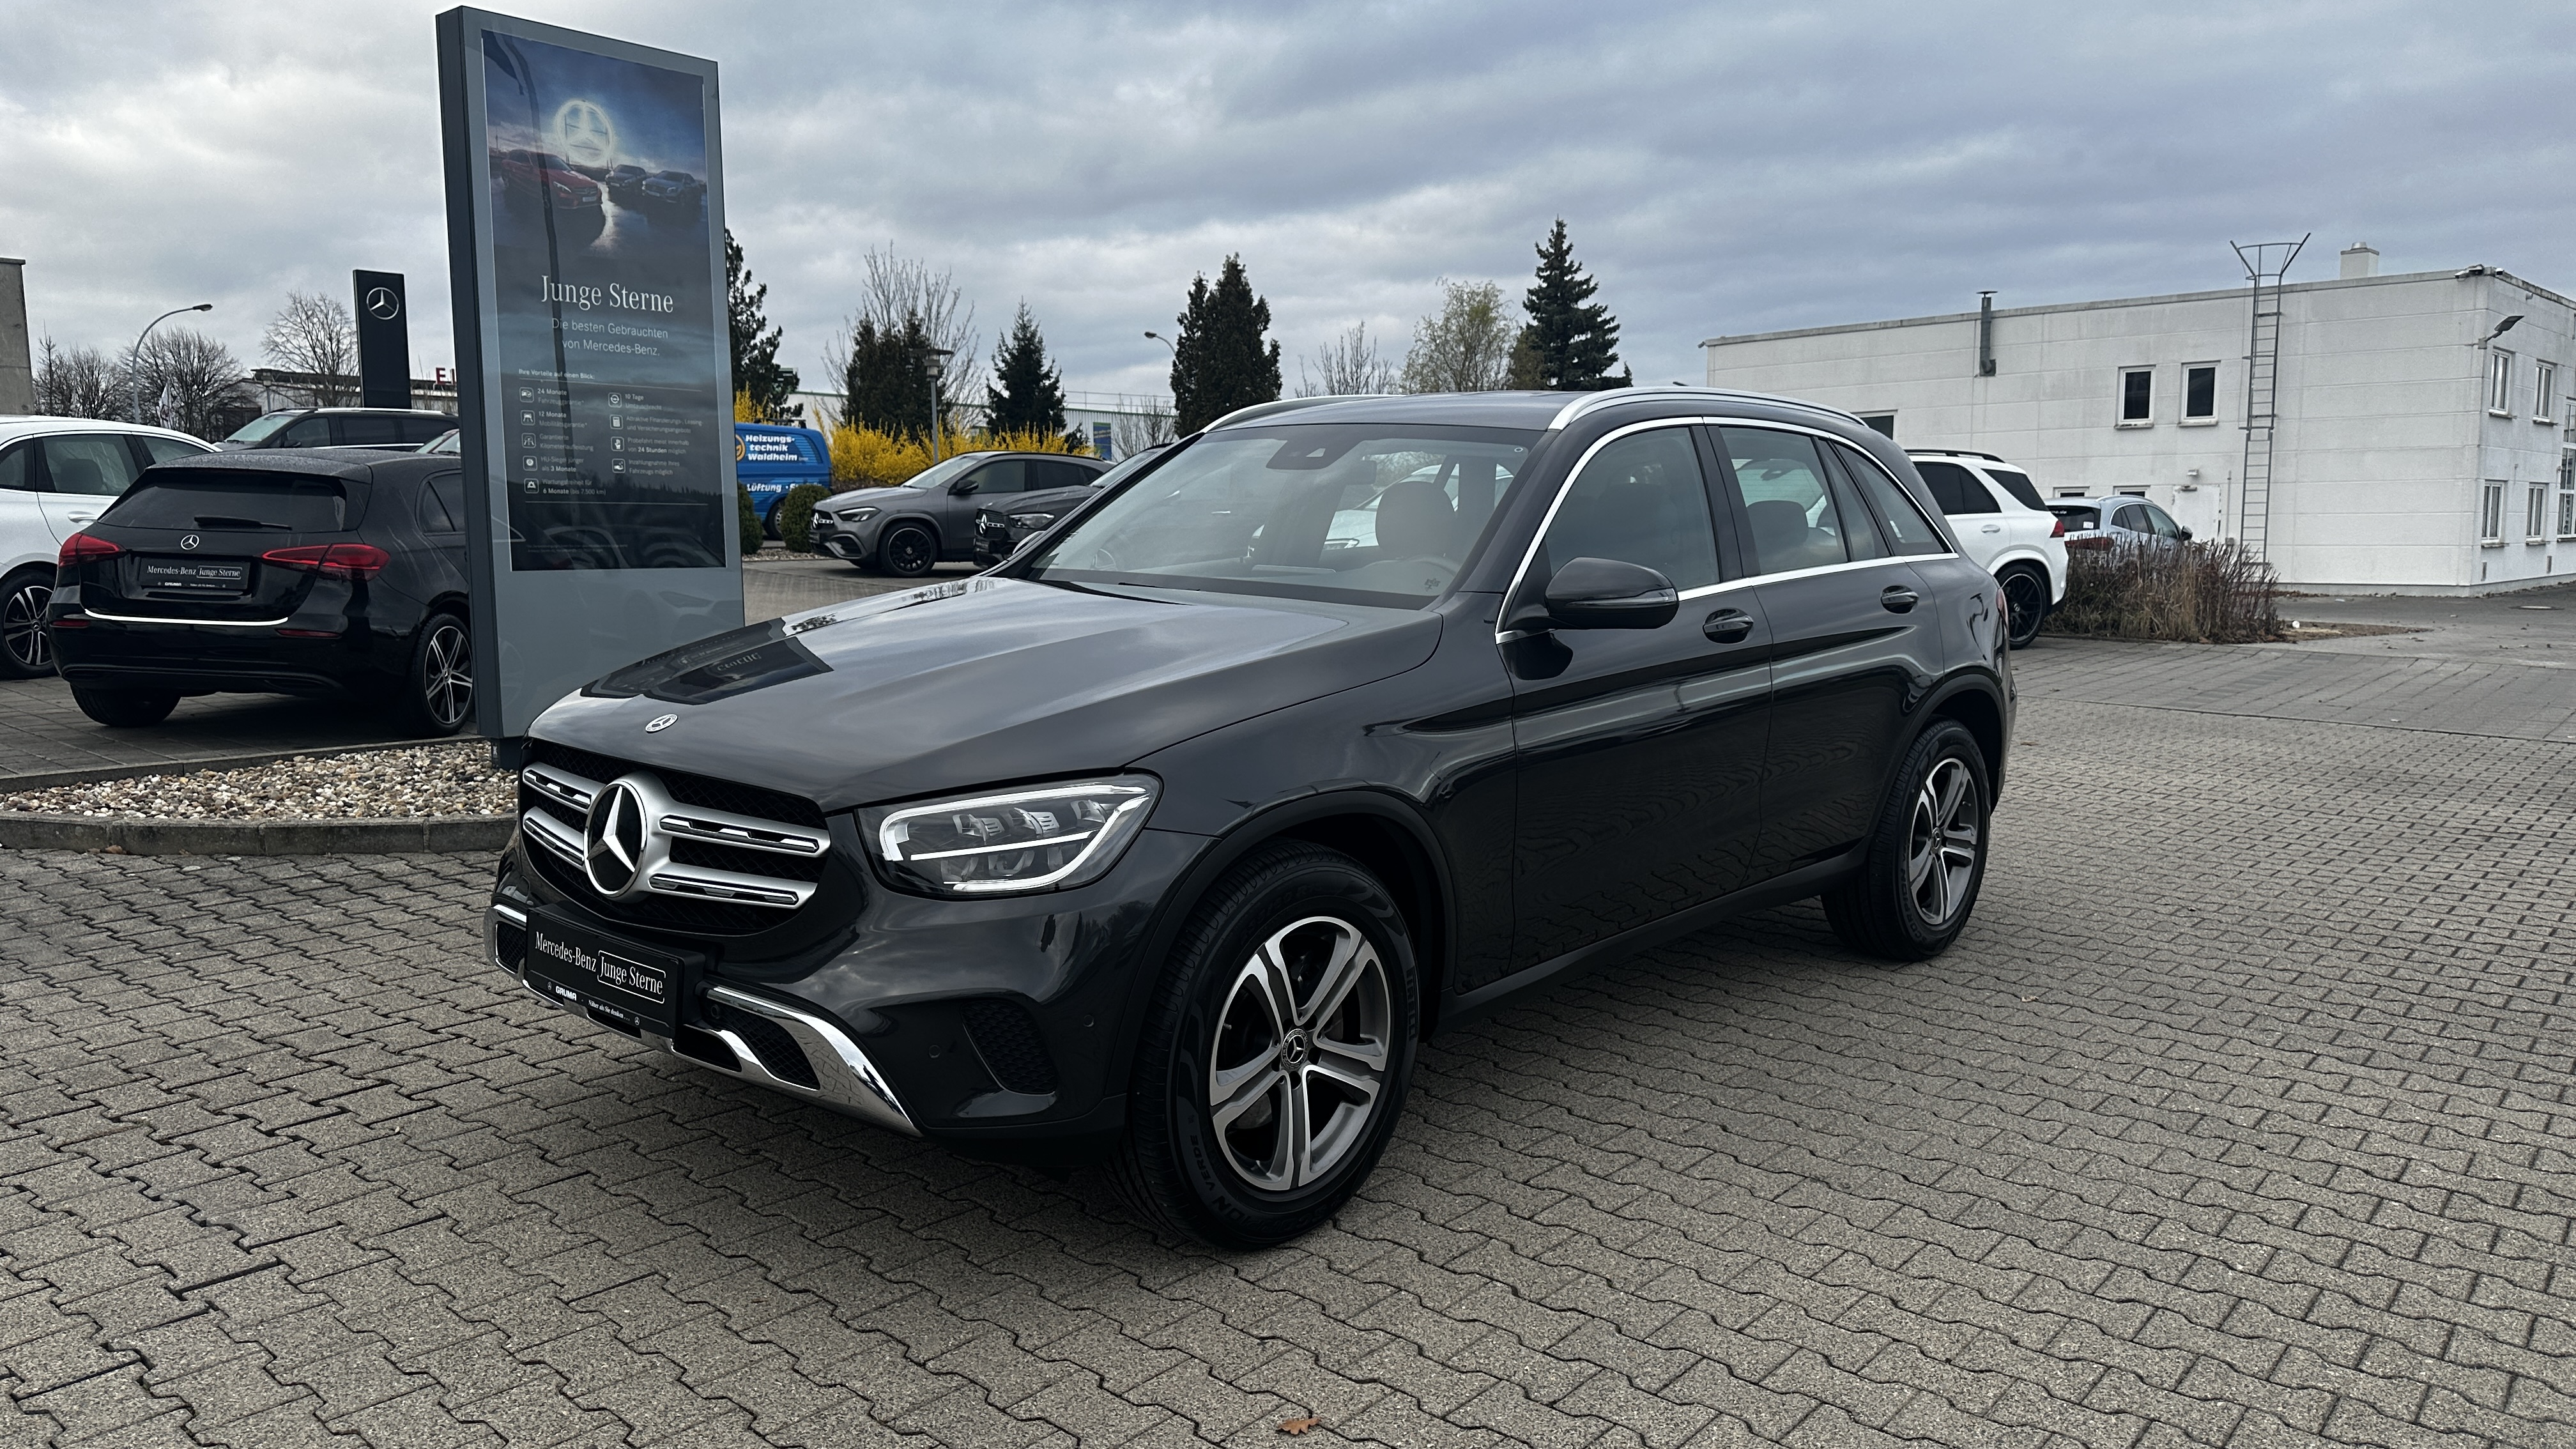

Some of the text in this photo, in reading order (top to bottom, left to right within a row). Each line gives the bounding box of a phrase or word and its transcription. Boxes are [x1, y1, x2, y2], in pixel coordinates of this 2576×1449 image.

[541, 275, 673, 313] Junge Sterne
[552, 318, 668, 339] Die besten Gebrauchten
[562, 339, 660, 356] von Mercedes-Benz.
[746, 434, 795, 443] Heizungs-
[749, 443, 788, 452] technik
[747, 483, 782, 493] Lüftung
[146, 565, 241, 577] Mercedes-Benz Junge Sterne
[535, 931, 664, 995] Mercedes-Benz Junge Sterne
[555, 985, 577, 1001] GRUMA
[1406, 965, 1417, 1041] PIRELLI
[1190, 1134, 1216, 1190] VERDE
